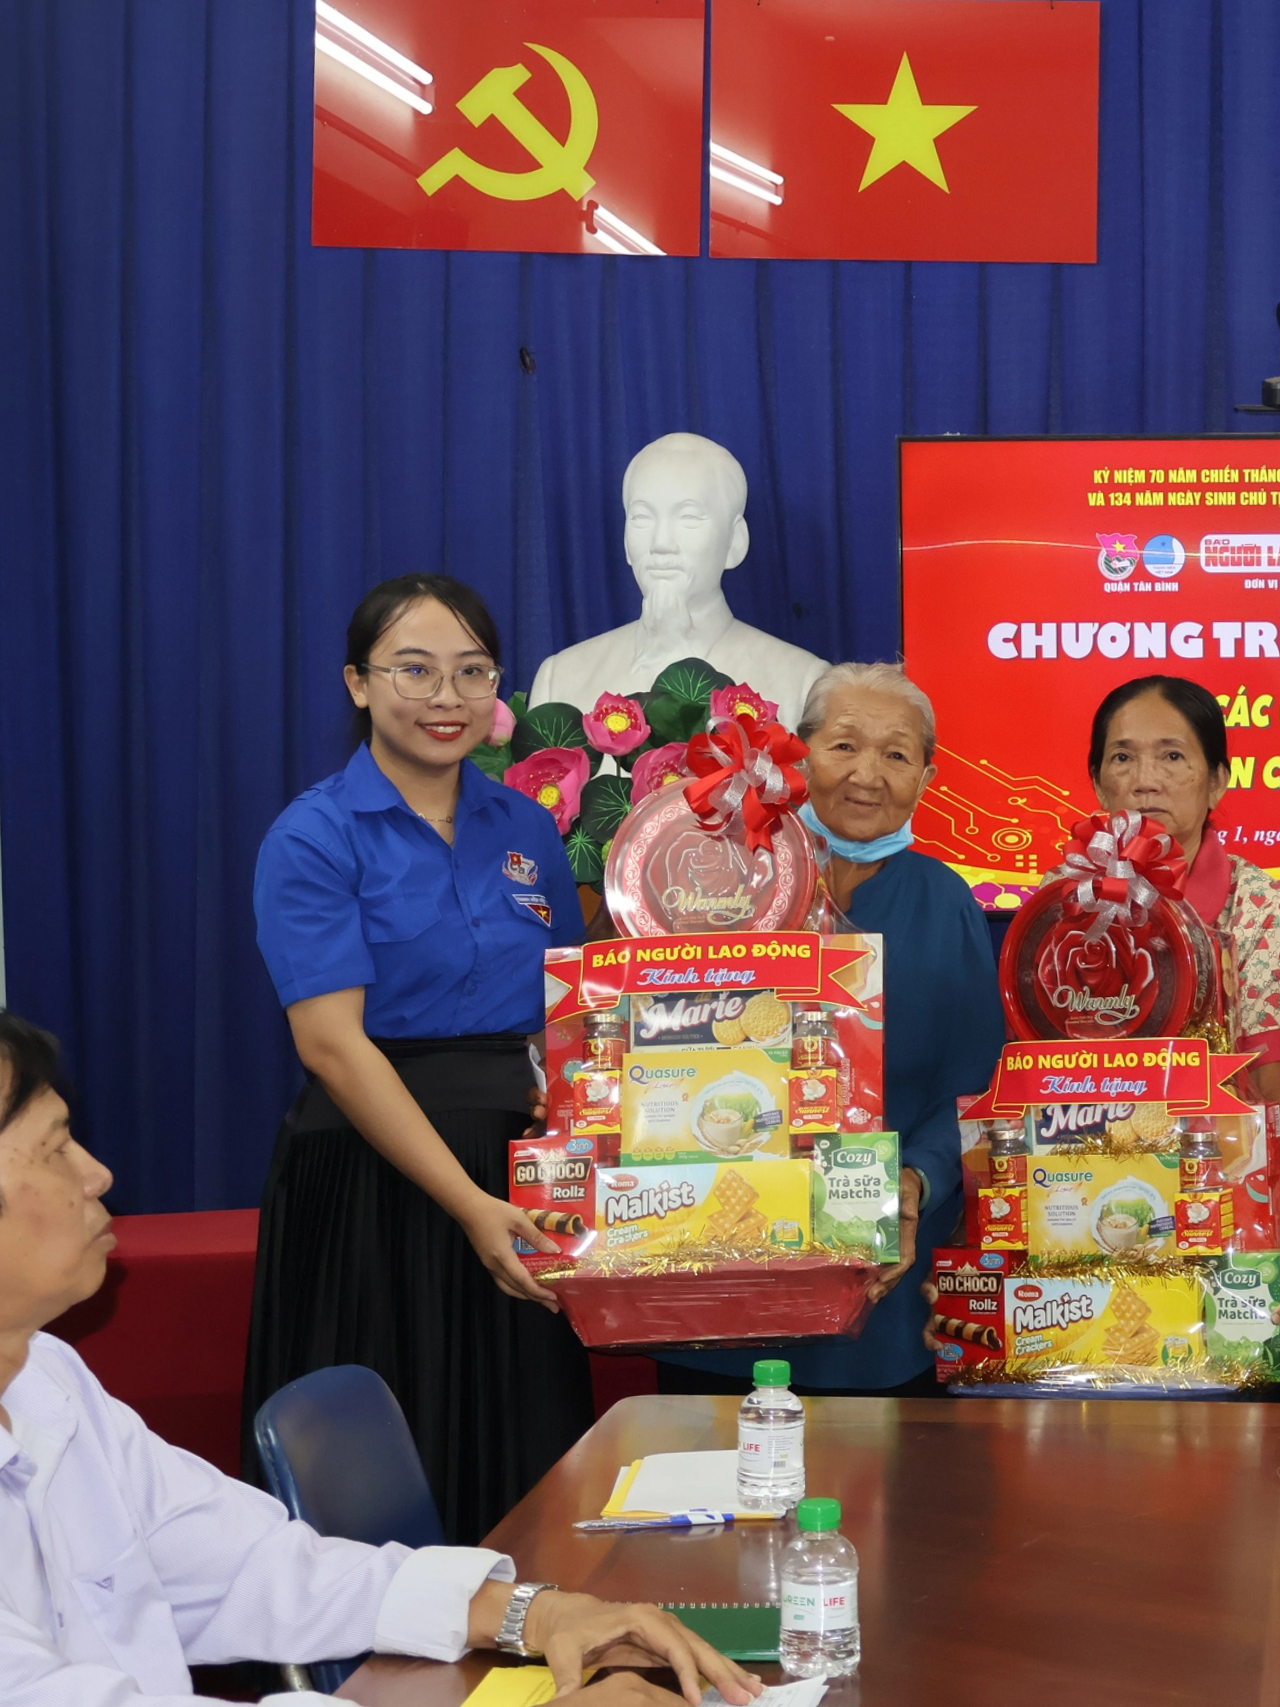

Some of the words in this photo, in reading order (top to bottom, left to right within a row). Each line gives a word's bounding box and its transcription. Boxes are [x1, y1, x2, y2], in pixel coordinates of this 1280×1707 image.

[1093, 467, 1110, 483] KỶ
[1114, 468, 1146, 486] NIỆM
[1150, 469, 1165, 483] 70
[1168, 466, 1197, 483] NĂM
[1201, 465, 1239, 483] CHIẾN
[1087, 490, 1105, 506] VÀ
[1108, 492, 1131, 506] 134
[1135, 489, 1164, 506] NĂM
[1167, 489, 1201, 506] NGÀY
[1205, 491, 1236, 505] SINH
[1240, 488, 1267, 505] CHỦ
[1204, 544, 1262, 567] NGƯỜI
[1104, 582, 1130, 593] QUẬN
[1133, 581, 1151, 592] TÂN
[1155, 580, 1179, 592] BÌNH
[1244, 578, 1265, 589] ĐƠN
[1267, 579, 1278, 590] VỊ
[987, 622, 1204, 660] CHƯƠNG
[662, 884, 757, 925] Warmly
[592, 947, 631, 967] BÁO
[636, 942, 702, 962] NGƯỜI
[708, 945, 748, 959] LAO
[751, 941, 811, 962] ĐỘNG
[636, 967, 700, 985] Kính
[703, 967, 756, 986] tặng
[1052, 983, 1140, 1025] Warmly
[640, 991, 745, 1039] Marie
[1006, 1052, 1034, 1071] BÁO
[1038, 1050, 1098, 1070] NGƯỜI
[1103, 1052, 1138, 1068] LAO
[1143, 1048, 1200, 1070] ĐỘNG
[629, 1064, 697, 1085] Quasure
[1040, 1075, 1097, 1094] Kính
[1100, 1076, 1148, 1096] tặng
[641, 1100, 679, 1108] NUTRITIOUS
[644, 1106, 675, 1114] SOLUTION
[1040, 1103, 1136, 1138] Marie
[836, 1151, 872, 1166] Cozy
[516, 1165, 535, 1182] GO
[537, 1162, 585, 1180] CHOCO
[1033, 1168, 1094, 1188] Quasure
[611, 1180, 635, 1188] Roma
[828, 1175, 851, 1188] Trà
[854, 1174, 881, 1187] sữa
[552, 1185, 586, 1199] Rollz
[828, 1188, 881, 1200] Matcha
[605, 1181, 695, 1225] Malkist
[606, 1224, 638, 1238] Cream
[938, 1276, 954, 1292] GO
[955, 1276, 998, 1292] CHOCO
[1223, 1272, 1258, 1287] Cozy
[1017, 1290, 1039, 1298] Roma
[1217, 1296, 1238, 1308] Trà
[968, 1298, 998, 1311] Rollz
[1013, 1292, 1094, 1335] Malkist
[1015, 1334, 1043, 1346] Cream
[742, 1442, 760, 1452] LIFE
[823, 1597, 846, 1607] LIFE
